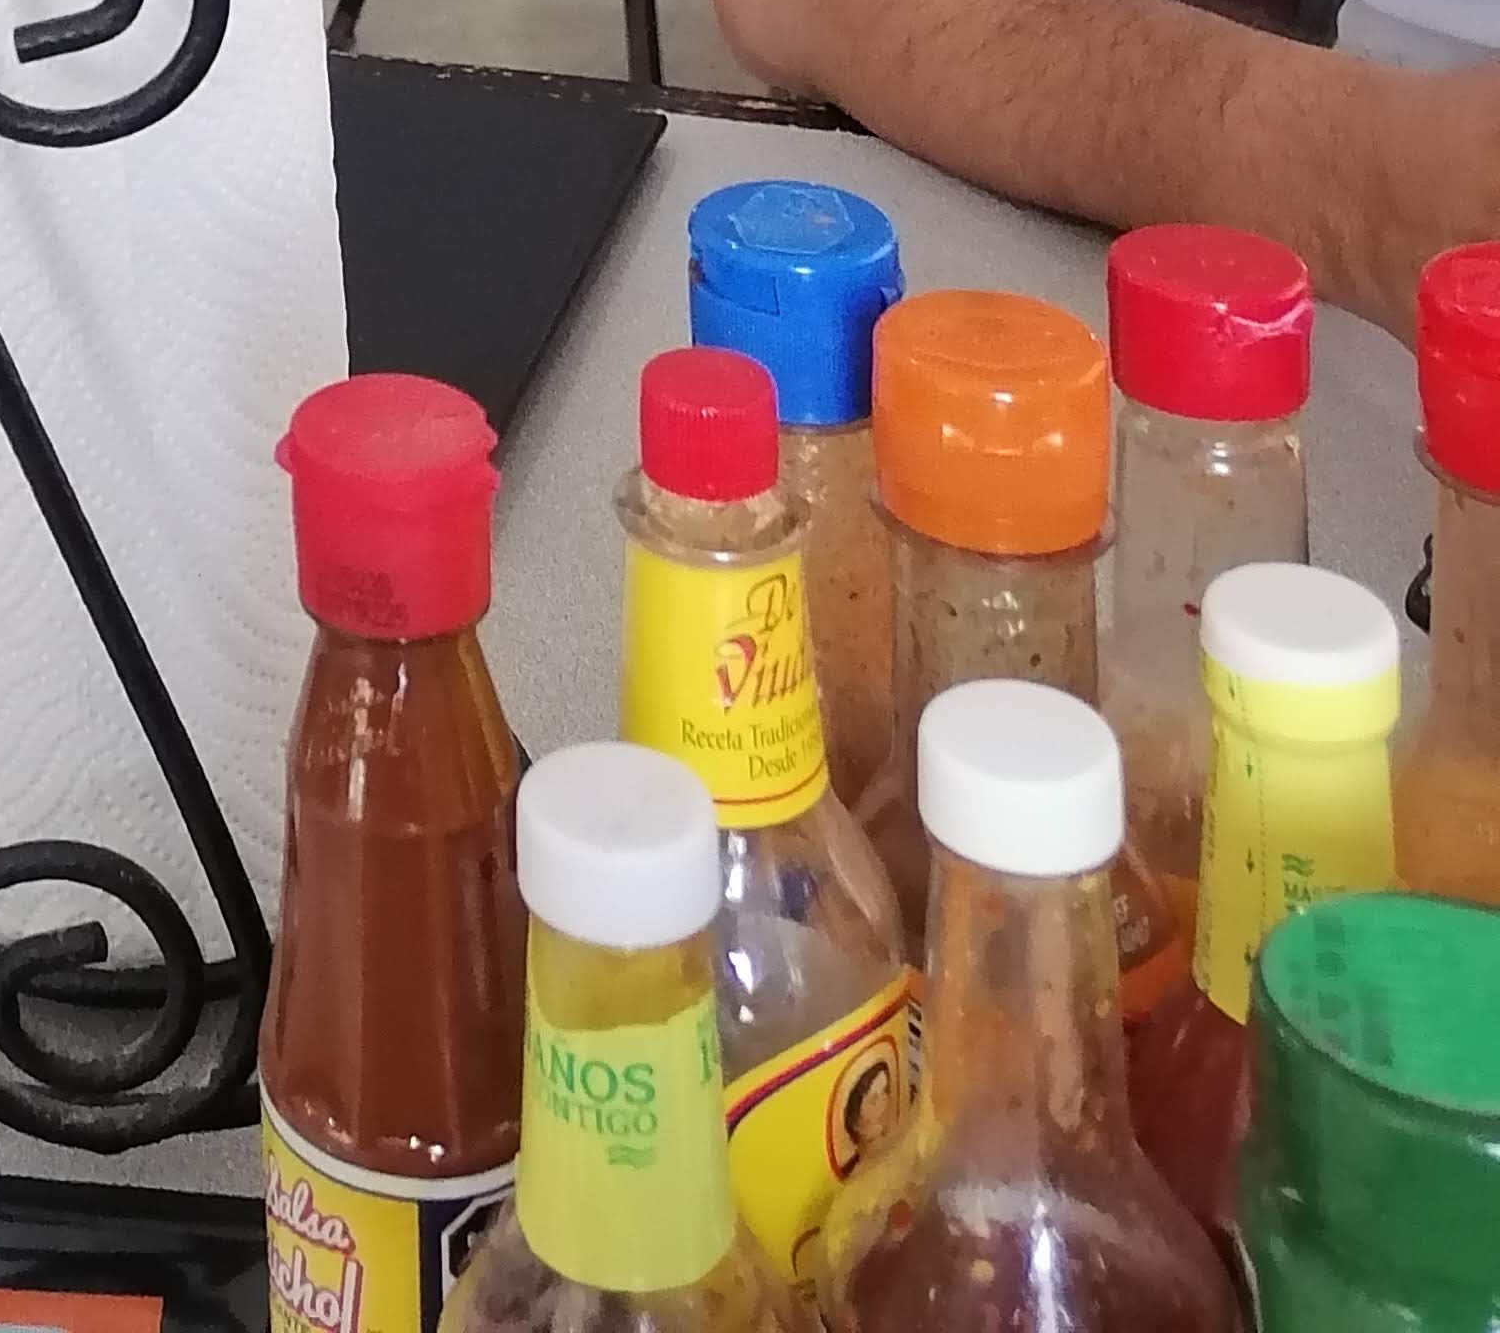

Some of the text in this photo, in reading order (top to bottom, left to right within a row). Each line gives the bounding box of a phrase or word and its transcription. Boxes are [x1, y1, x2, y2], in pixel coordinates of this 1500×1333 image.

[680, 716, 743, 751] Receta
[748, 746, 797, 781] Desde
[265, 1149, 356, 1253] Salsa
